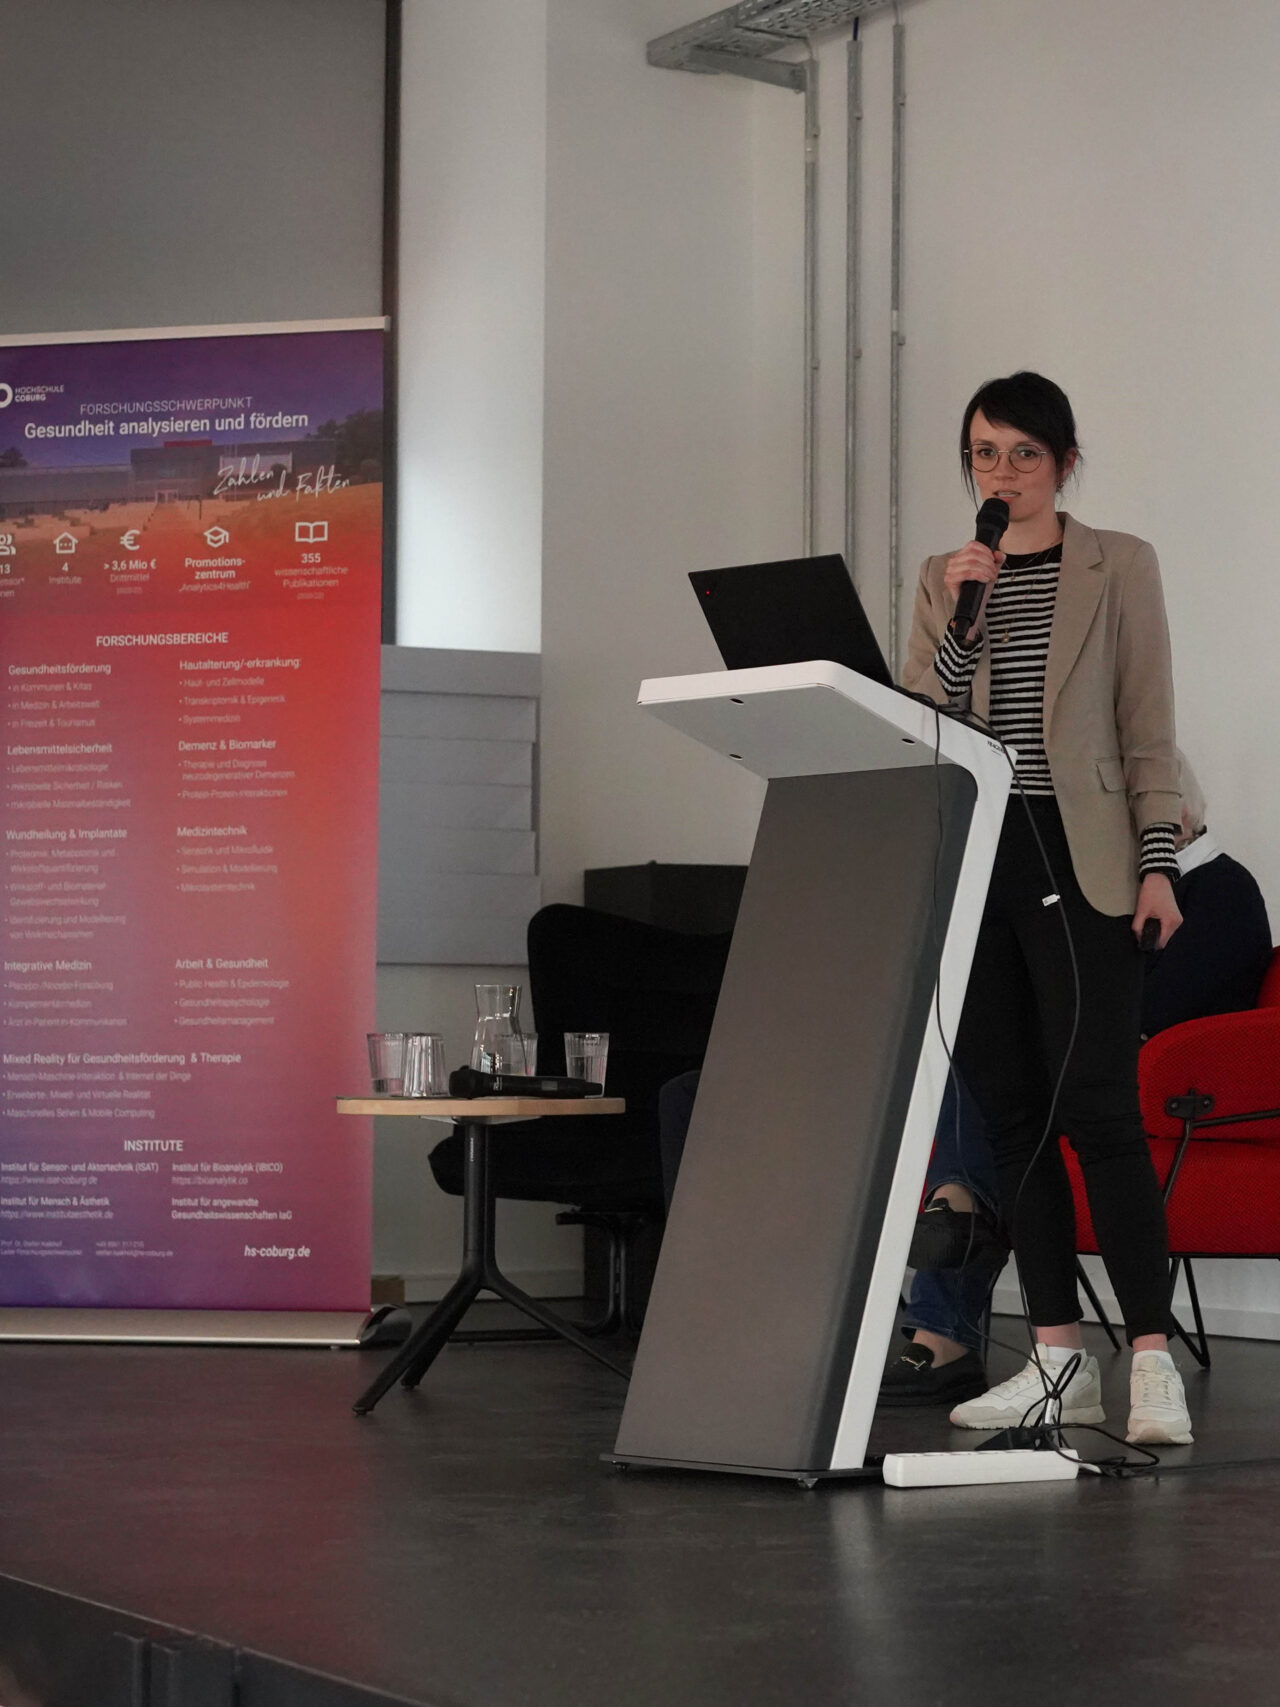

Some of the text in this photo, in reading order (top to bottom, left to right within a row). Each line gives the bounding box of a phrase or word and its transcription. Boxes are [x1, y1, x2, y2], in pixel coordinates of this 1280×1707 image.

[15, 385, 65, 394] HOCHSCHULE
[15, 394, 46, 402] COBURG
[80, 396, 253, 416] FORSCHUNGSSCHWERPUNKT
[25, 411, 309, 439] Gesundheit analysieren und fördern
[213, 453, 274, 495] Zahlen
[257, 464, 350, 502] und Fakten
[111, 560, 127, 571] 3,6
[129, 559, 148, 570] Mio
[150, 558, 157, 569] €
[184, 556, 246, 568] Promotions-
[301, 553, 321, 564] 355
[61, 562, 69, 572] 4
[195, 569, 236, 579] zentrum
[96, 632, 229, 647] FORSCHUNGSBEREICHE
[8, 663, 112, 676] Gesundheitsförderung
[7, 743, 113, 756] Lebensmittelsicherheit
[178, 738, 277, 751] Demenz & Biomarker
[177, 825, 248, 837] Medizintechnik
[4, 960, 92, 973] Integrative Medizin
[175, 958, 269, 969] Arbeit & Gesundheit
[3, 1052, 242, 1066] Mixed Reality für Gesundheitsförderung & Therapie
[124, 1139, 184, 1152] INSTITUTE
[244, 1244, 311, 1260] hs-coburg.de
